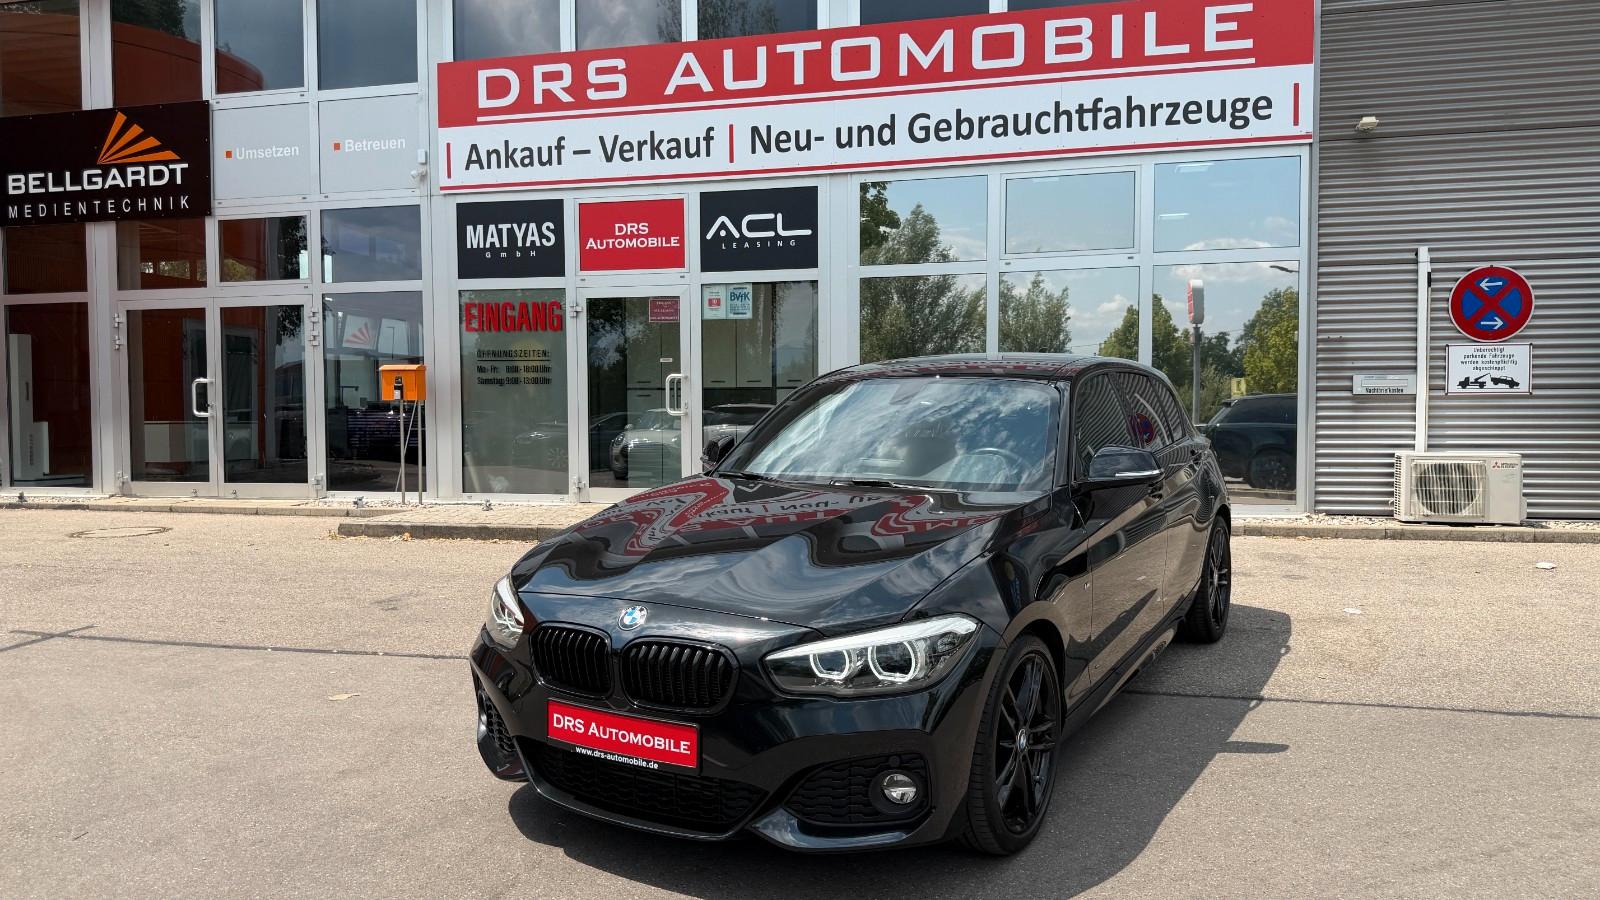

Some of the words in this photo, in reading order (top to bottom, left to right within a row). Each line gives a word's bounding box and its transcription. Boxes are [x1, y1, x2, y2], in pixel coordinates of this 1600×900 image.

[477, 58, 627, 109] DRS
[664, 3, 1254, 96] AUTOMOBILE
[344, 136, 406, 153] Betreuen
[465, 136, 565, 171] Ankauf
[599, 127, 714, 163] Verkauf
[750, 123, 824, 155] Neu-
[836, 114, 897, 149] und
[908, 94, 1273, 143] Gebrauchtfahrzeuge
[236, 144, 299, 161] Umsetzen
[7, 163, 189, 195] BELLGARDT
[8, 195, 190, 219] MEDIENTECHNIK
[466, 222, 556, 249] MATYAS
[614, 222, 649, 236] DRS
[706, 213, 813, 240] ACL
[722, 239, 796, 250] LEASING
[464, 300, 563, 333] EINGANG
[552, 713, 585, 734] DRS
[575, 745, 659, 770] www.drs-automobile.de
